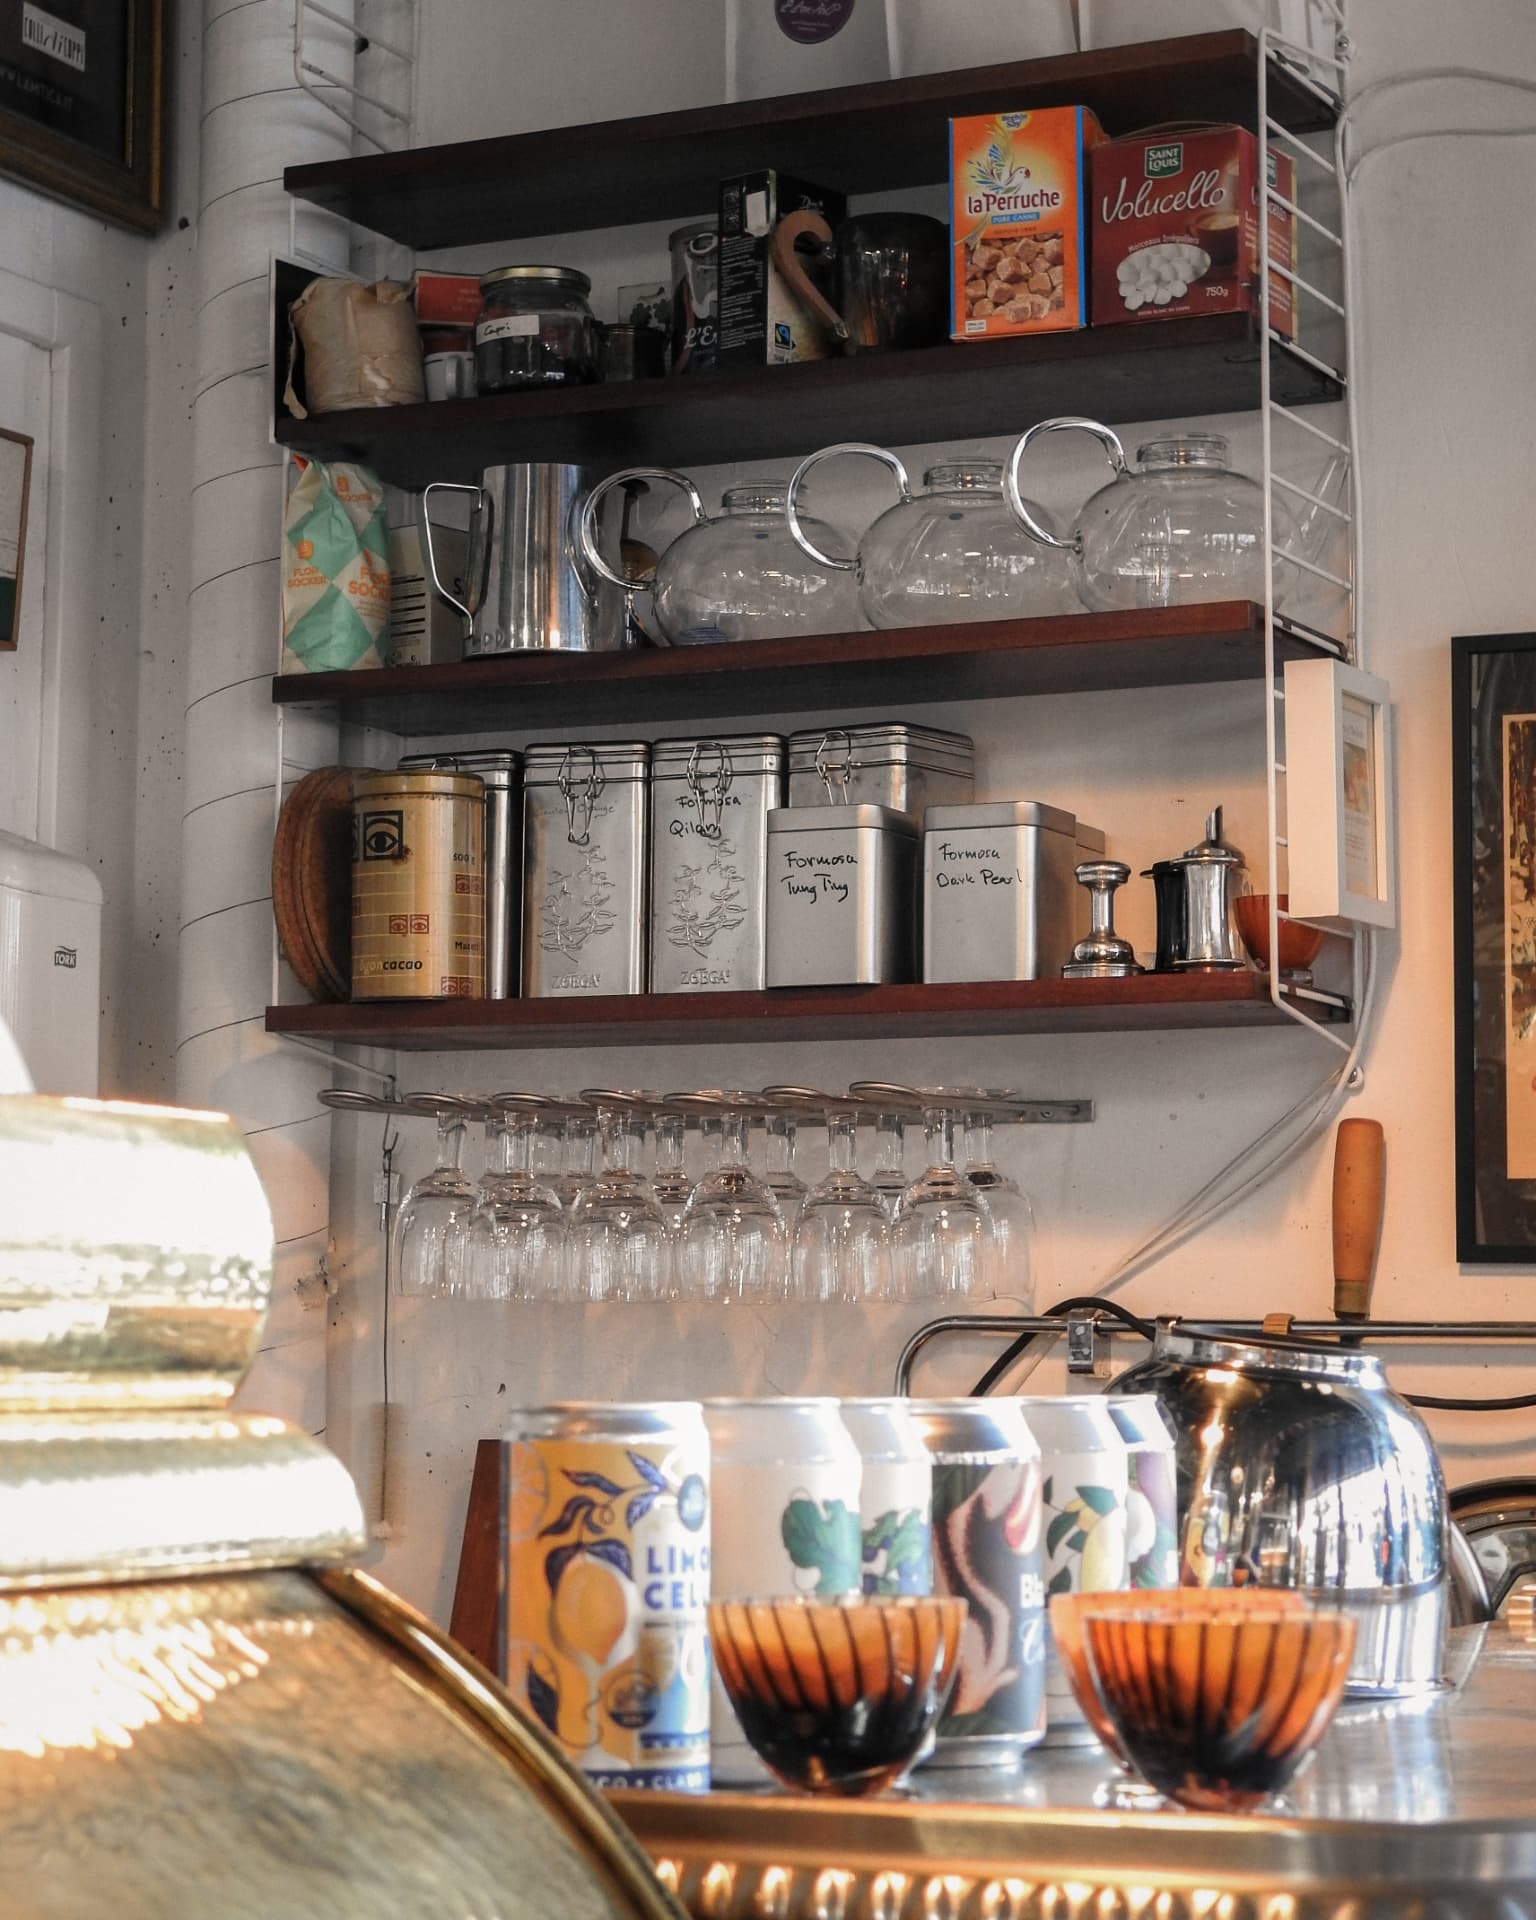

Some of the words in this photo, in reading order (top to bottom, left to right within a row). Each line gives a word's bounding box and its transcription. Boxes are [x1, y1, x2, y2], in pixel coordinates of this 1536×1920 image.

[1149, 148, 1179, 160] SAINT
[1149, 158, 1179, 171] LOUIS
[1102, 169, 1226, 223] Volucello
[1206, 286, 1229, 297] 750g
[784, 851, 858, 869] Formosa
[938, 843, 1001, 862] Formosa
[936, 872, 975, 888] Dark
[980, 868, 1023, 886] Pearl
[55, 951, 76, 967] TORK
